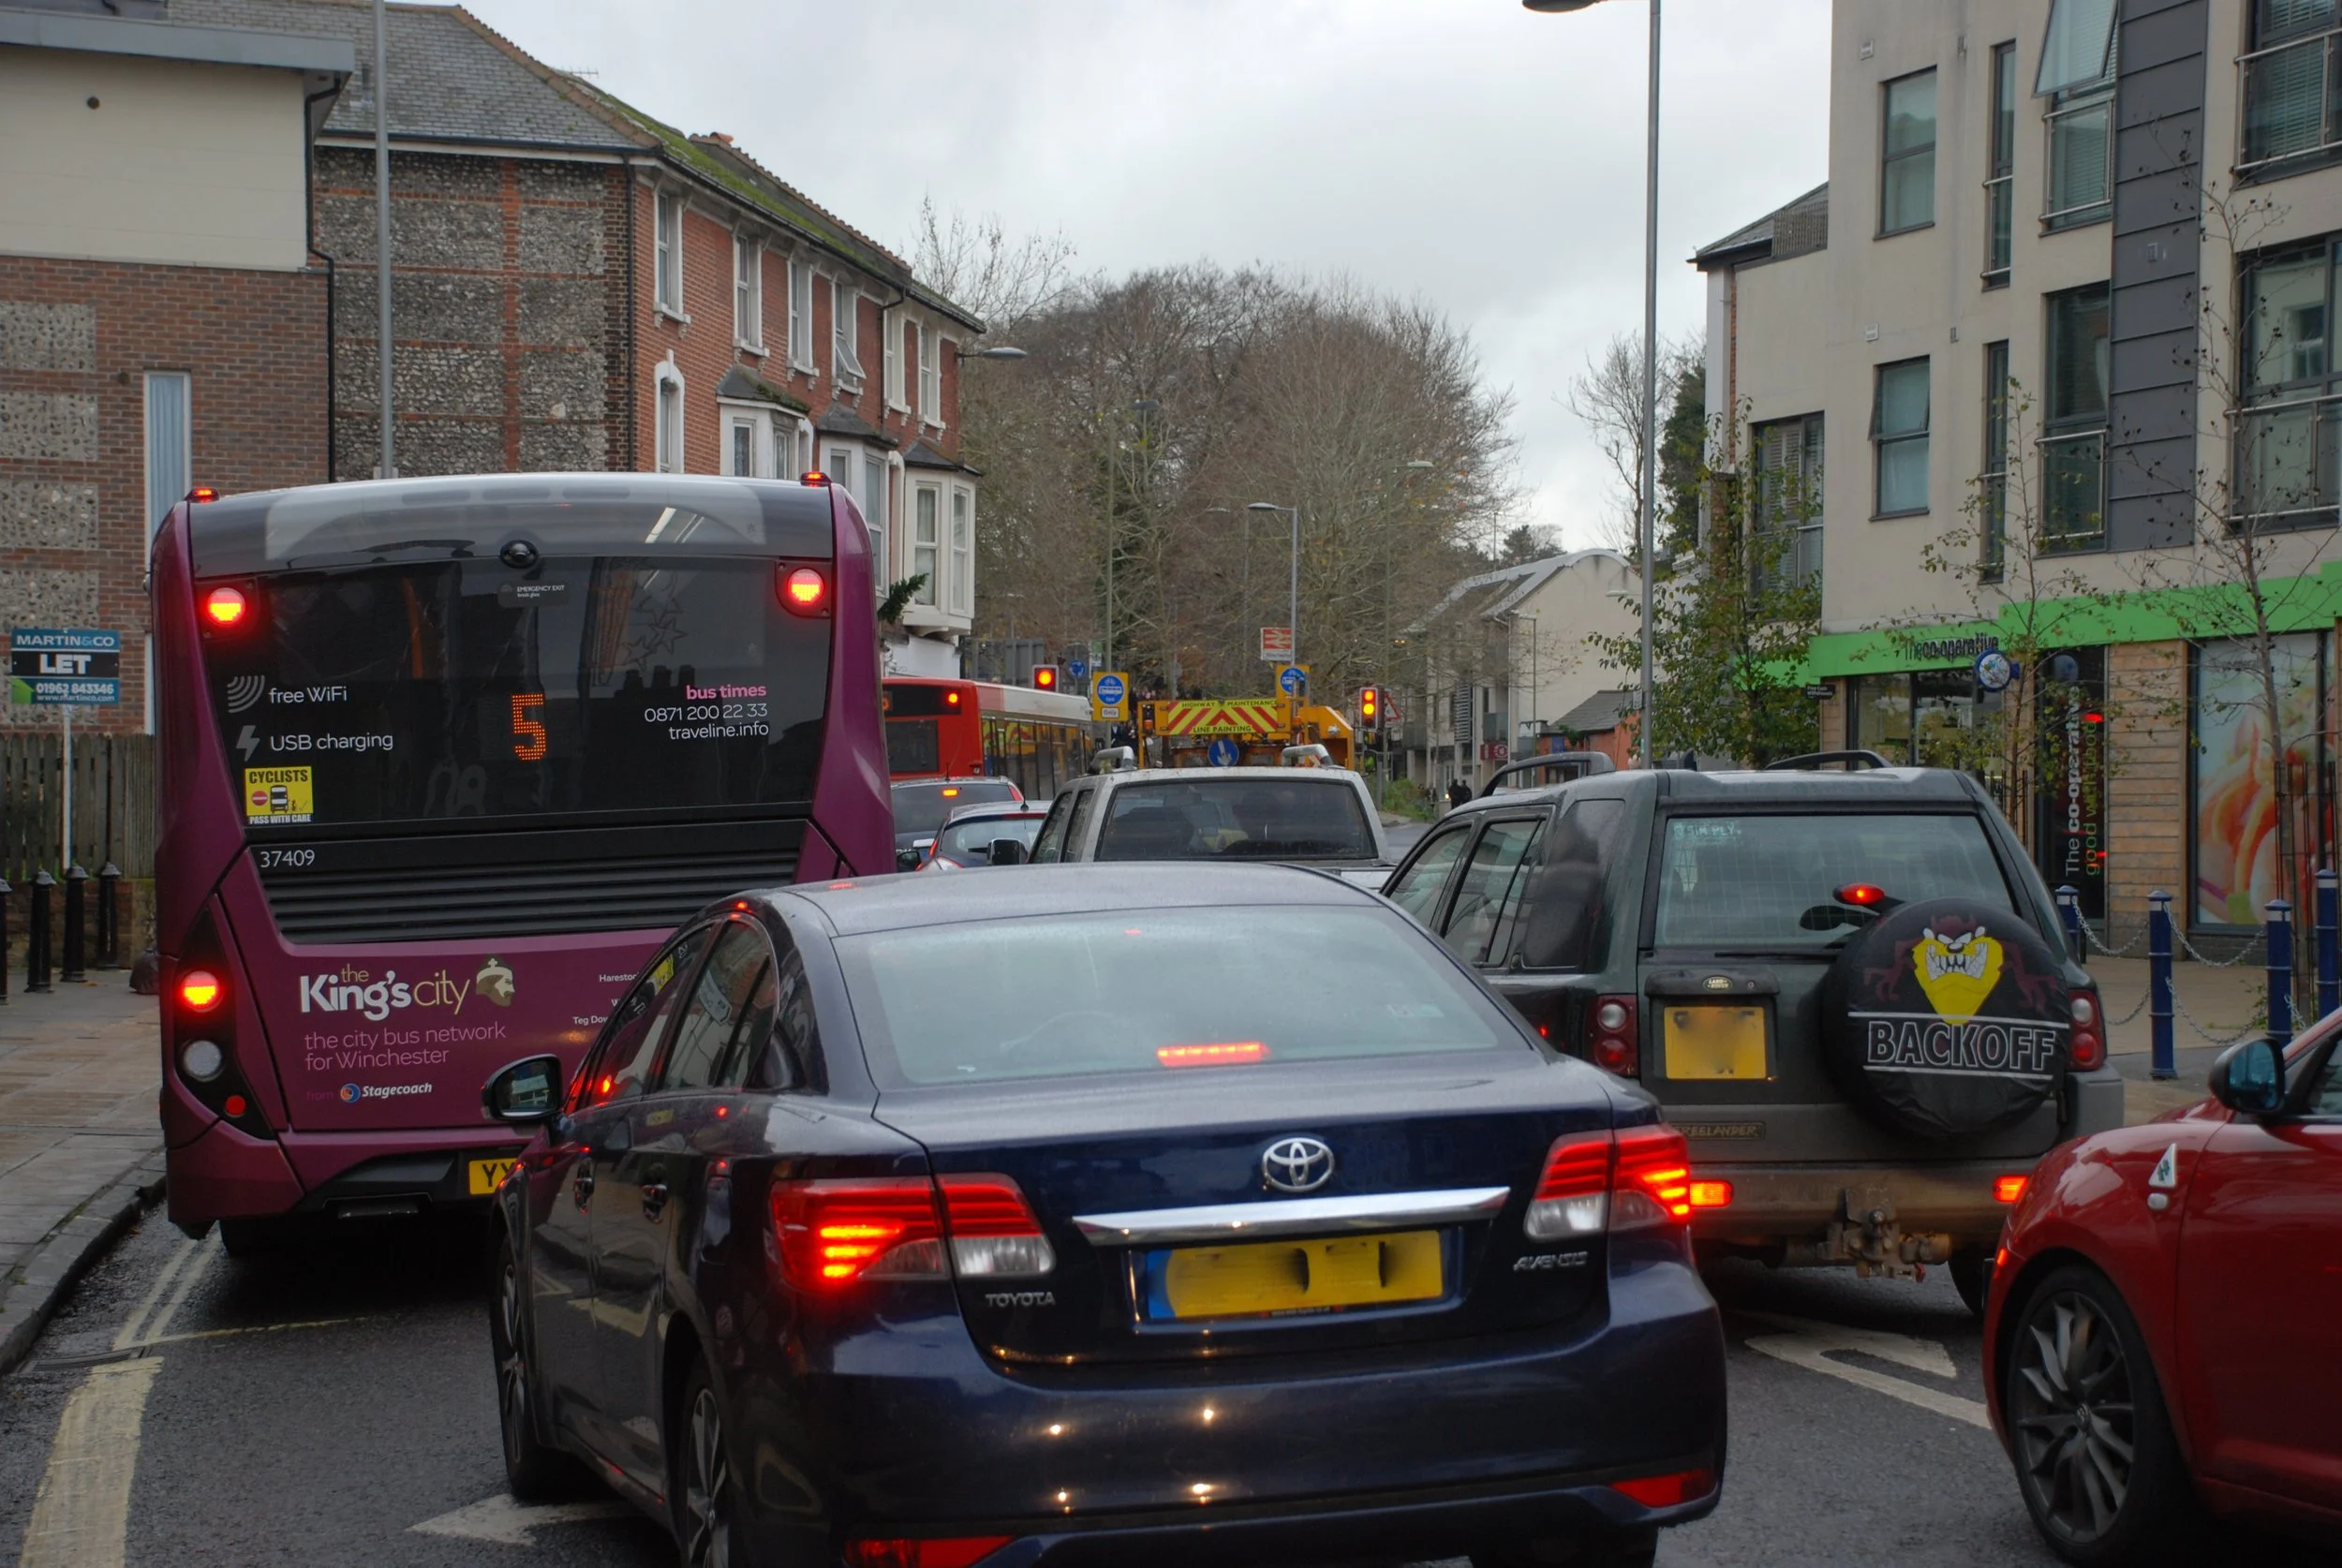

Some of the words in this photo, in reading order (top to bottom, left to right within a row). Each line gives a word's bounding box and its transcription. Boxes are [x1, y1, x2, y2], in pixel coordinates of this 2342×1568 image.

[17, 635, 115, 647] MARTIN&CO
[1922, 632, 1999, 663] co-operative
[39, 653, 92, 674] LET
[36, 683, 69, 694] 01962
[71, 683, 114, 695] 843346
[269, 688, 304, 703] free
[307, 686, 348, 702] WiFi
[686, 685, 717, 700] bus
[719, 684, 767, 698] times
[644, 707, 683, 722] 0871
[687, 705, 719, 720] 200
[722, 704, 743, 718] 22
[747, 703, 768, 717] 33
[512, 693, 546, 761] 5
[669, 720, 769, 740] traveline.info
[270, 734, 312, 751] USB
[317, 732, 393, 752] charging
[2066, 686, 2083, 834] co-operative
[249, 769, 308, 784] CYCLISTS
[249, 816, 269, 824] PASS
[291, 814, 311, 822] CARE
[259, 850, 315, 867] 37409
[2066, 837, 2080, 876] The
[2083, 822, 2099, 876] good
[341, 963, 369, 983] the
[300, 970, 412, 1021] King's
[413, 969, 470, 1015] city
[572, 1016, 588, 1026] Teg
[304, 1032, 338, 1050] the
[343, 1030, 378, 1050] city
[384, 1028, 421, 1046] bus
[425, 1021, 506, 1043] network
[1868, 1021, 2055, 1071] BACKOFF
[305, 1054, 334, 1071] for
[335, 1049, 450, 1069] Winchester
[306, 1090, 334, 1101] from
[362, 1083, 433, 1099] Stagecoach
[985, 1292, 1056, 1308] TOYOTA
